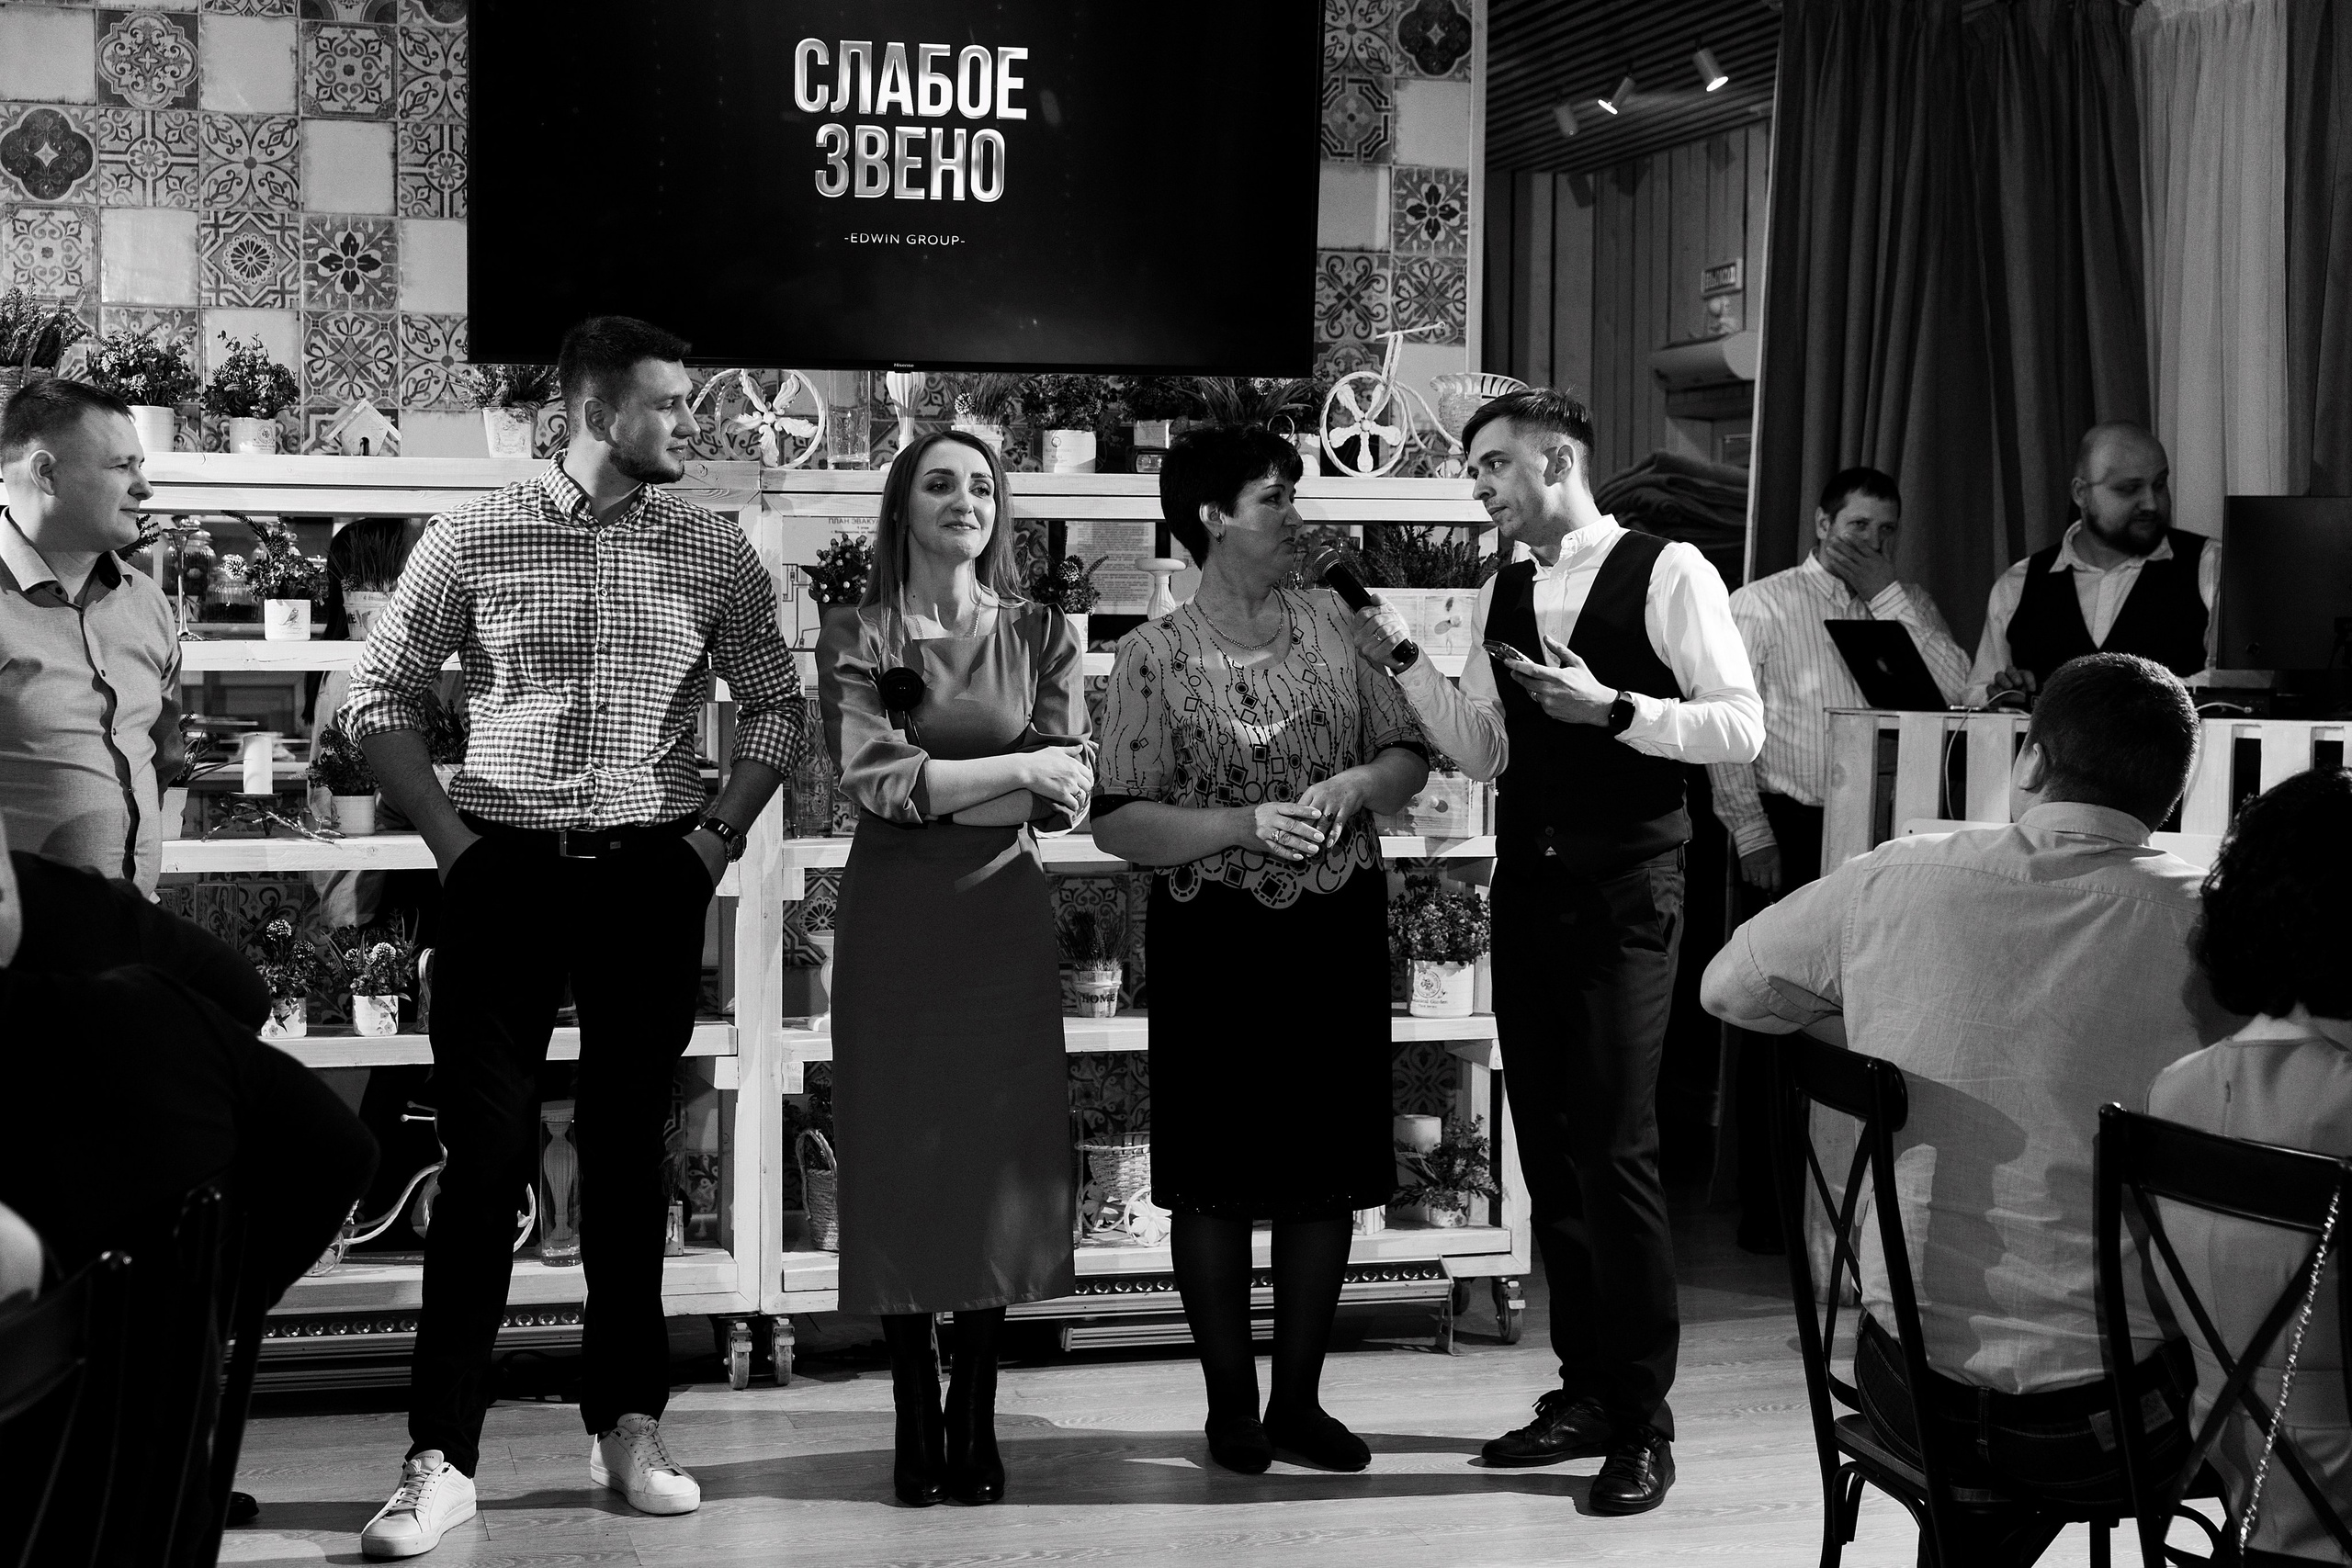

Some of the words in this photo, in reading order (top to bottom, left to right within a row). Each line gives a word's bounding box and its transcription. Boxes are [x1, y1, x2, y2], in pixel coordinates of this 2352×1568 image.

[794, 38, 1029, 119] СЛАБОЕ
[815, 123, 1006, 202] ЗВЕНО
[844, 232, 899, 244] -EDWIN
[906, 234, 966, 246] GROUP-
[1081, 992, 1115, 1004] HOME
